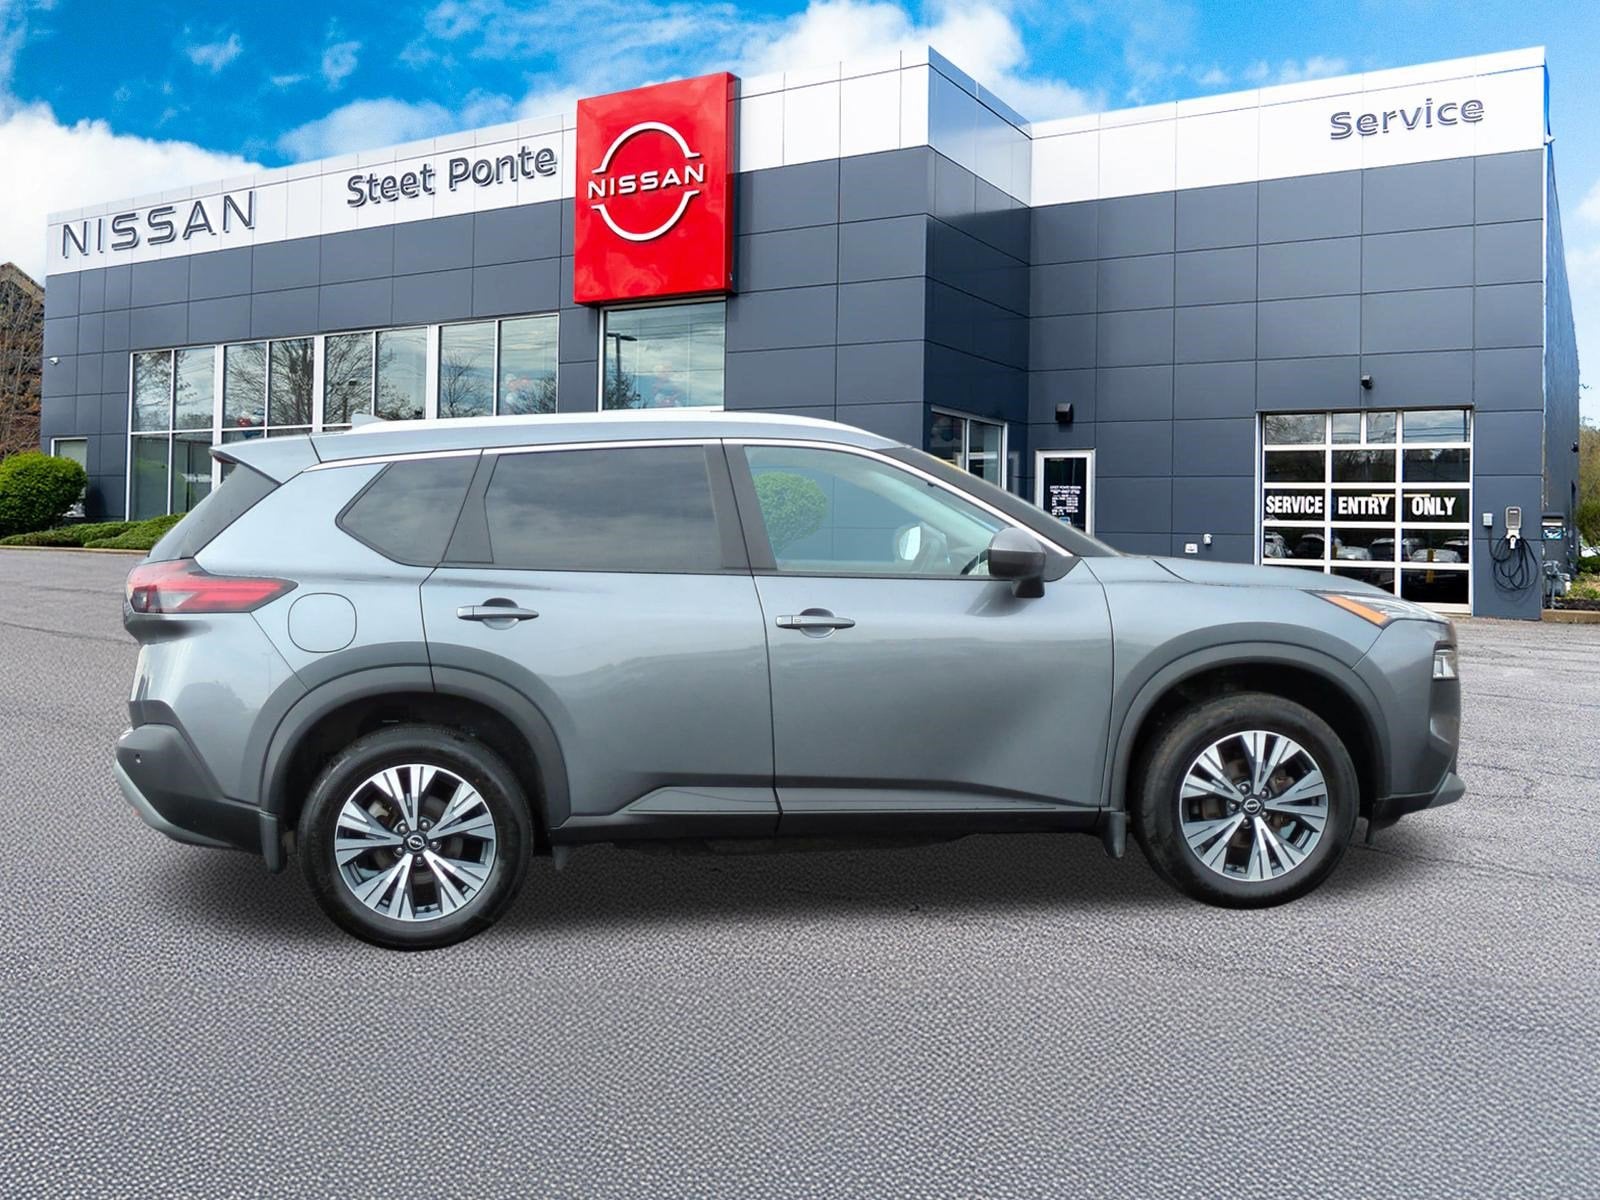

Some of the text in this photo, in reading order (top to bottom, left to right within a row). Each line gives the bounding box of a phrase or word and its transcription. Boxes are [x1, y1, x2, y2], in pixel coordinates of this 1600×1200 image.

[1330, 98, 1485, 140] Service
[347, 146, 557, 208] Steet Ponte
[587, 163, 705, 200] NISSAN
[62, 190, 256, 259] NISSAN
[1265, 495, 1456, 516] SERVICE ENTRY ONLY
